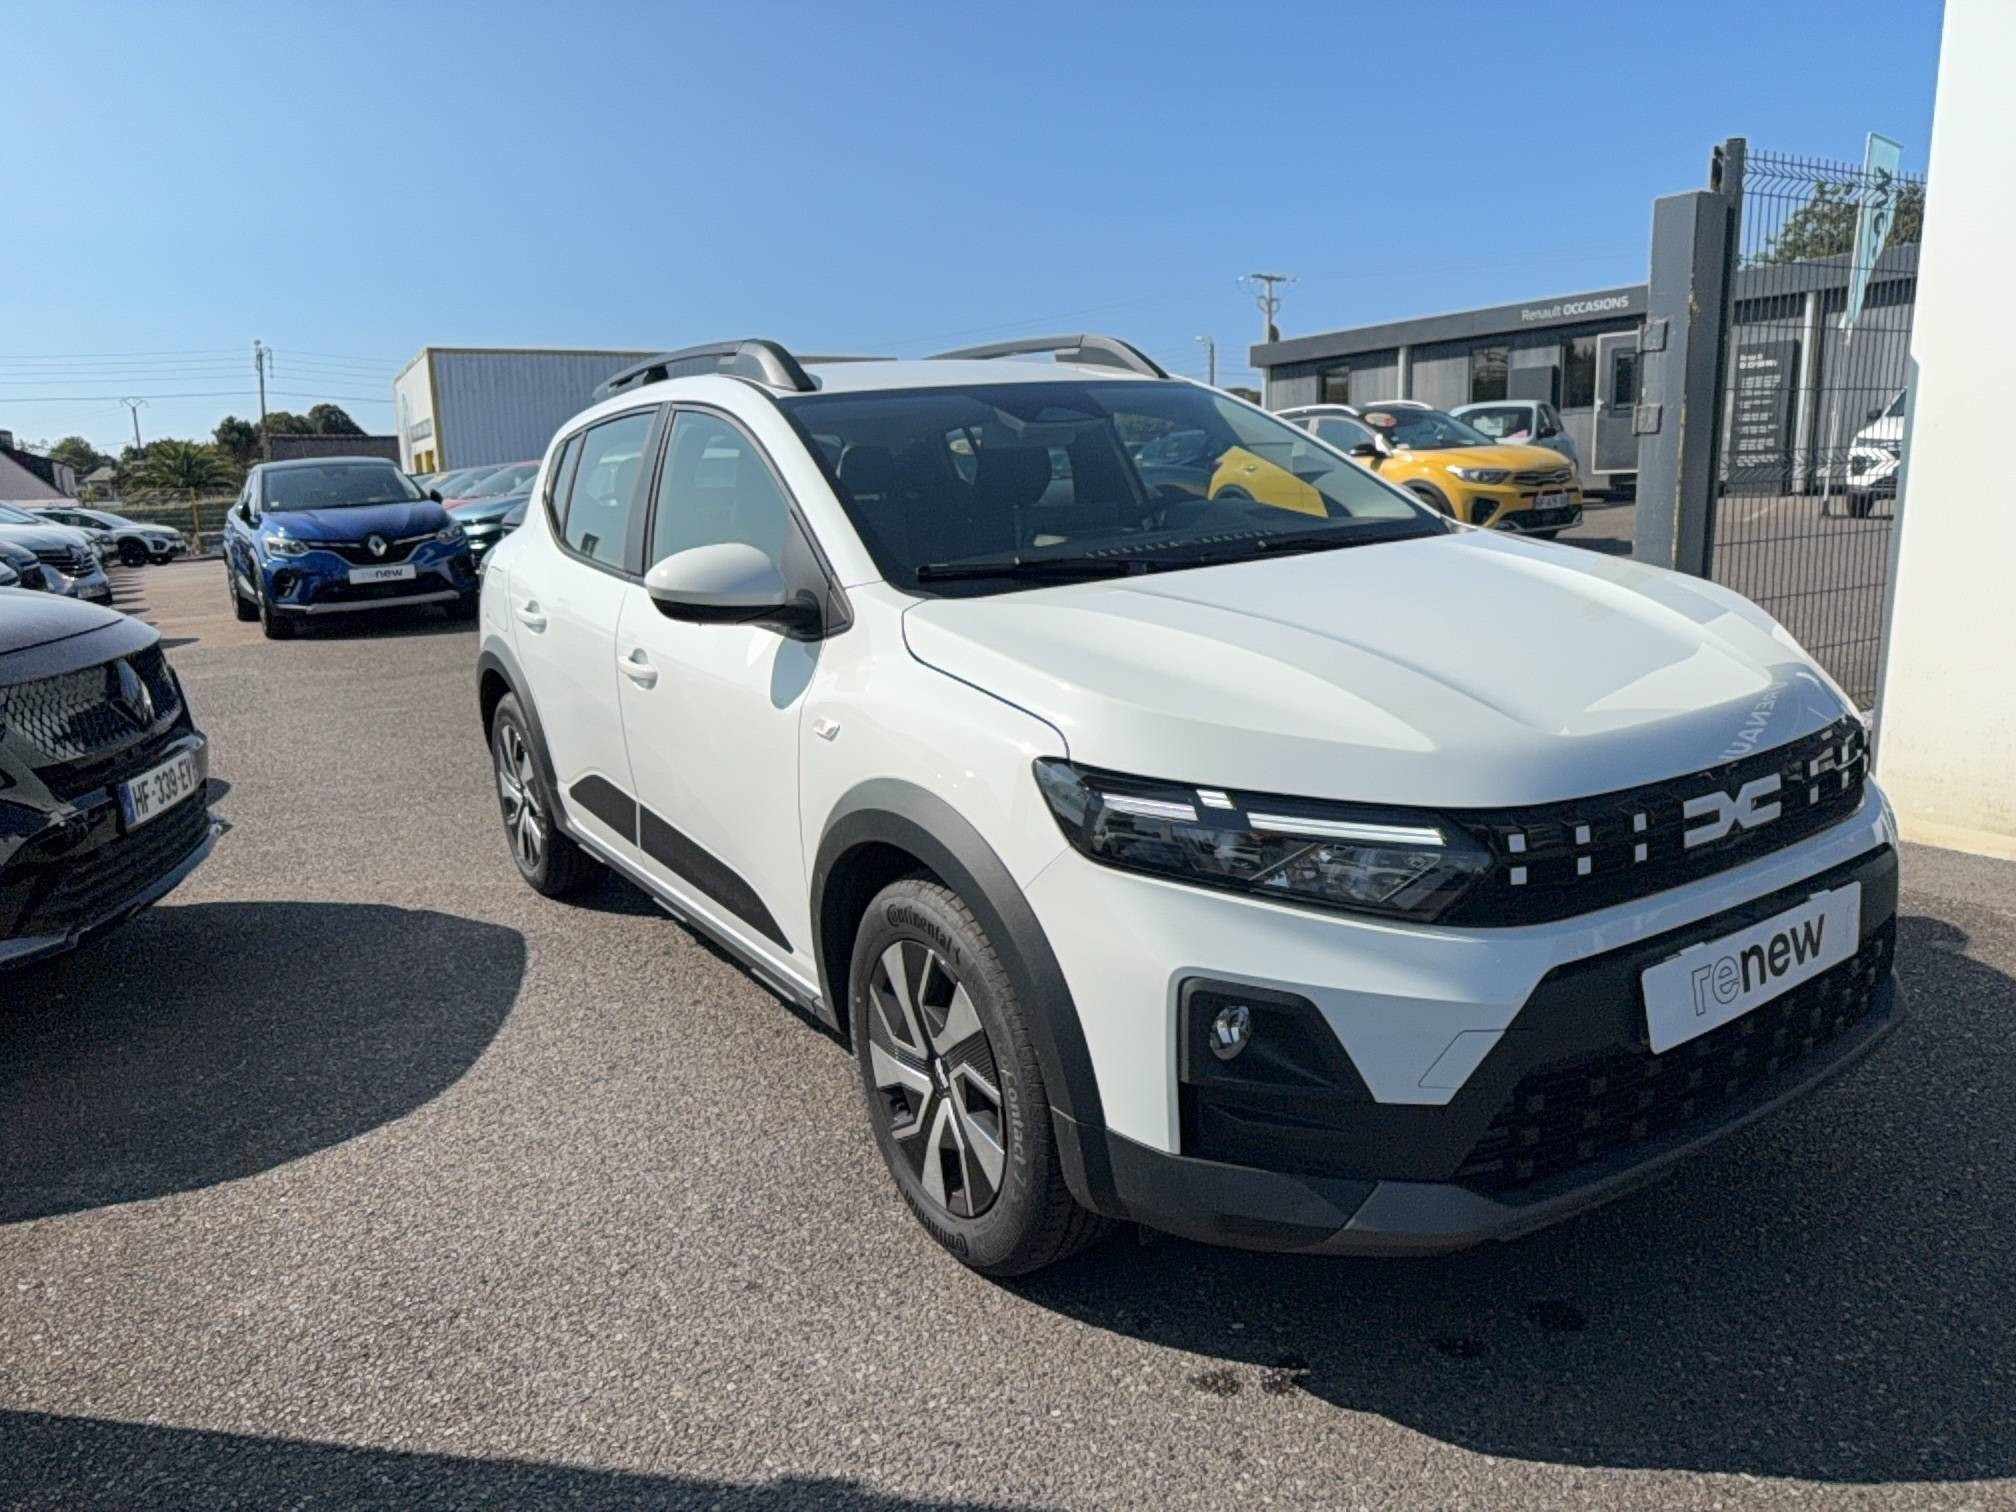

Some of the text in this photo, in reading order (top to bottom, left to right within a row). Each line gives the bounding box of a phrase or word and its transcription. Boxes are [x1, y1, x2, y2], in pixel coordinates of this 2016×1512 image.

[1521, 295, 1629, 321] Renault OCCASIONS
[1691, 913, 1825, 1017] renew
